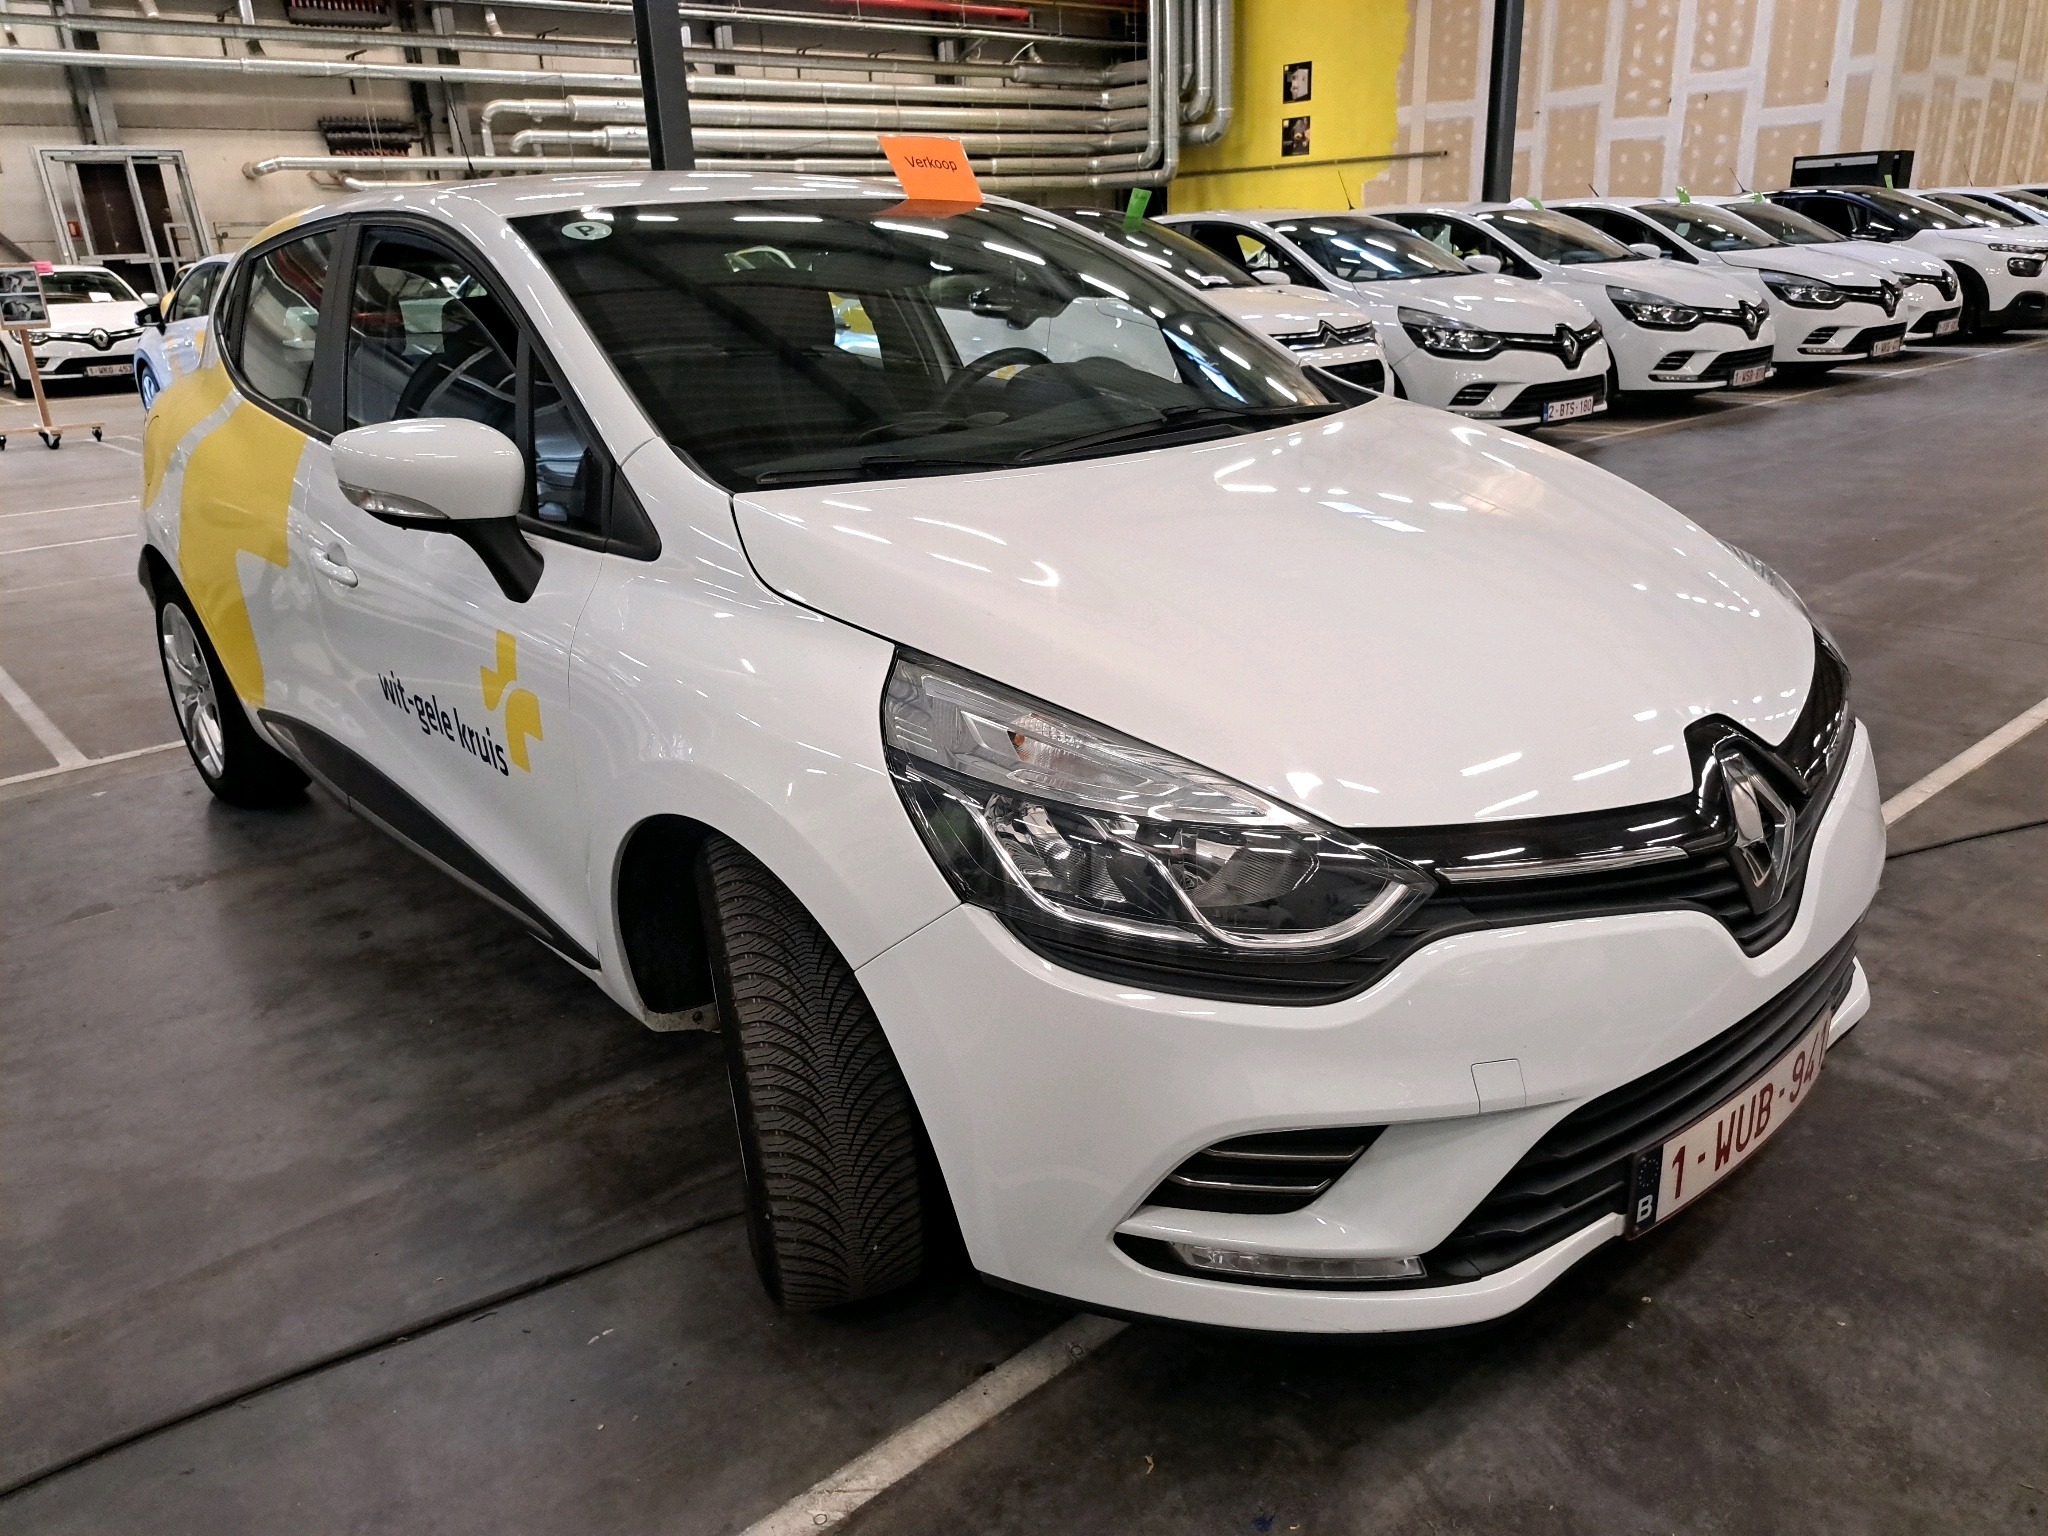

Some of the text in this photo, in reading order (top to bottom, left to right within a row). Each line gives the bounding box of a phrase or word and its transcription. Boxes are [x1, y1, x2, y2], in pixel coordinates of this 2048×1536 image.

[904, 156, 958, 172] Verkoop
[574, 225, 595, 237] P
[378, 670, 509, 777] wit-gele kruis
[1636, 1194, 1654, 1224] B
